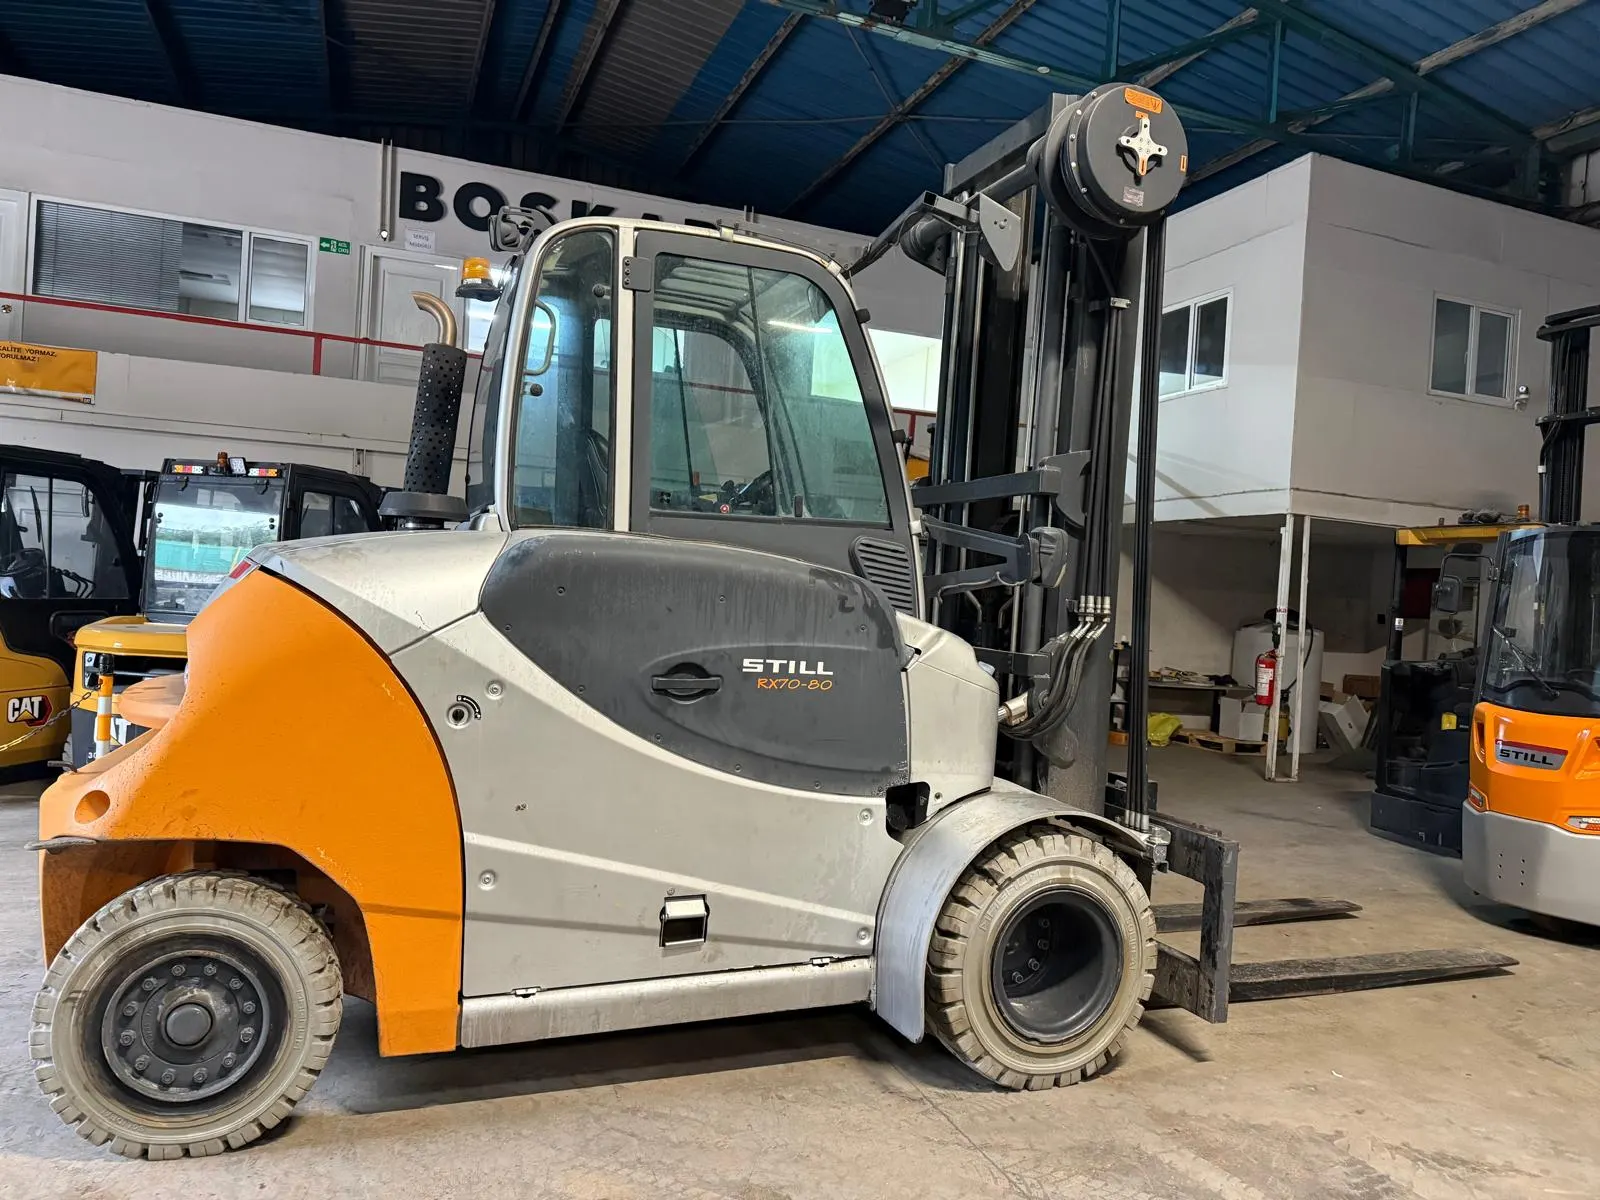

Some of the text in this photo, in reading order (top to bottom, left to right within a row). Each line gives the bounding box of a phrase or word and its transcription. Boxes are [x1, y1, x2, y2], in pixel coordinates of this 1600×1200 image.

[742, 658, 834, 675] STILL
[757, 678, 833, 690] RX70-80
[7, 696, 43, 723] CAT
[93, 716, 132, 748] AT
[1499, 748, 1554, 766] STILL
